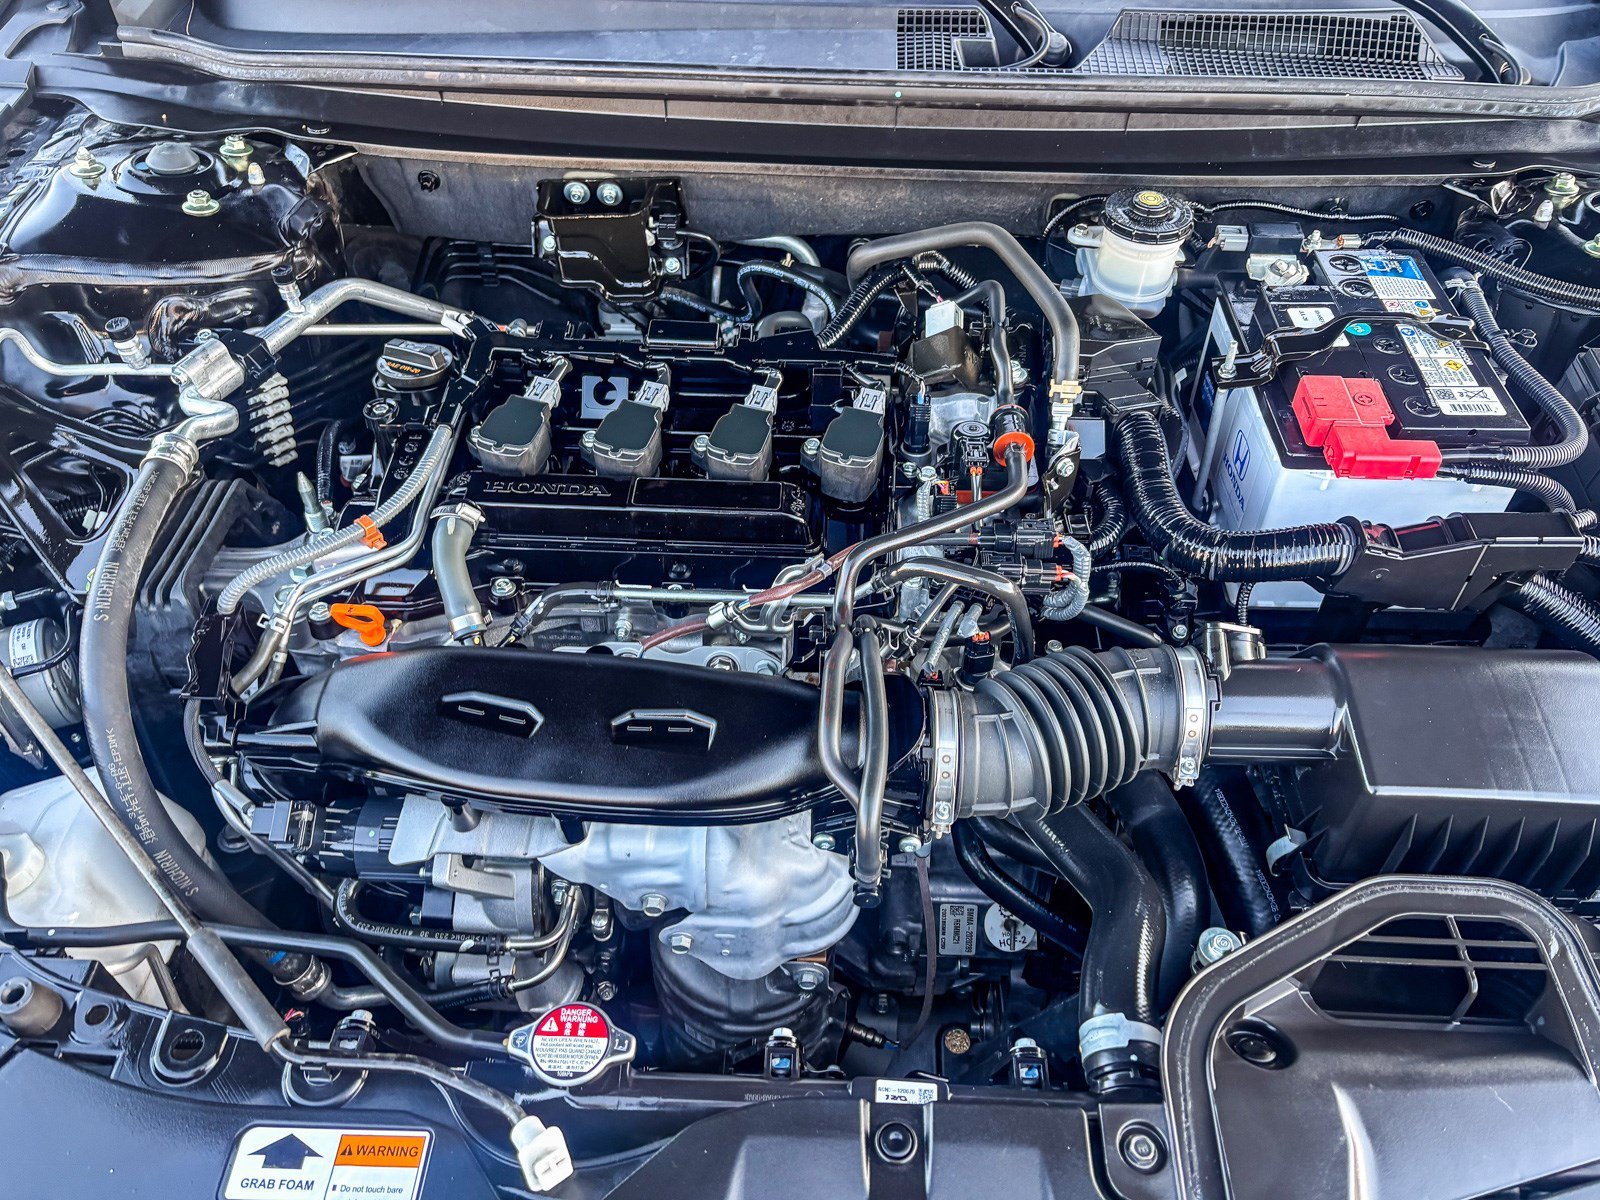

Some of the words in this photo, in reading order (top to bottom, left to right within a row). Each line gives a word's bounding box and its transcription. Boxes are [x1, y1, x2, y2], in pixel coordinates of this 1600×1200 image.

[1222, 452, 1245, 512] HONDA
[483, 481, 611, 497] HONDA
[561, 1008, 592, 1016] DANGER
[356, 1145, 419, 1157] WARNING
[240, 1178, 275, 1190] GRAB
[278, 1179, 315, 1191] FOAM
[339, 1184, 351, 1193] Do
[352, 1185, 365, 1193] not
[365, 1185, 385, 1194] touch
[386, 1186, 403, 1194] bare
